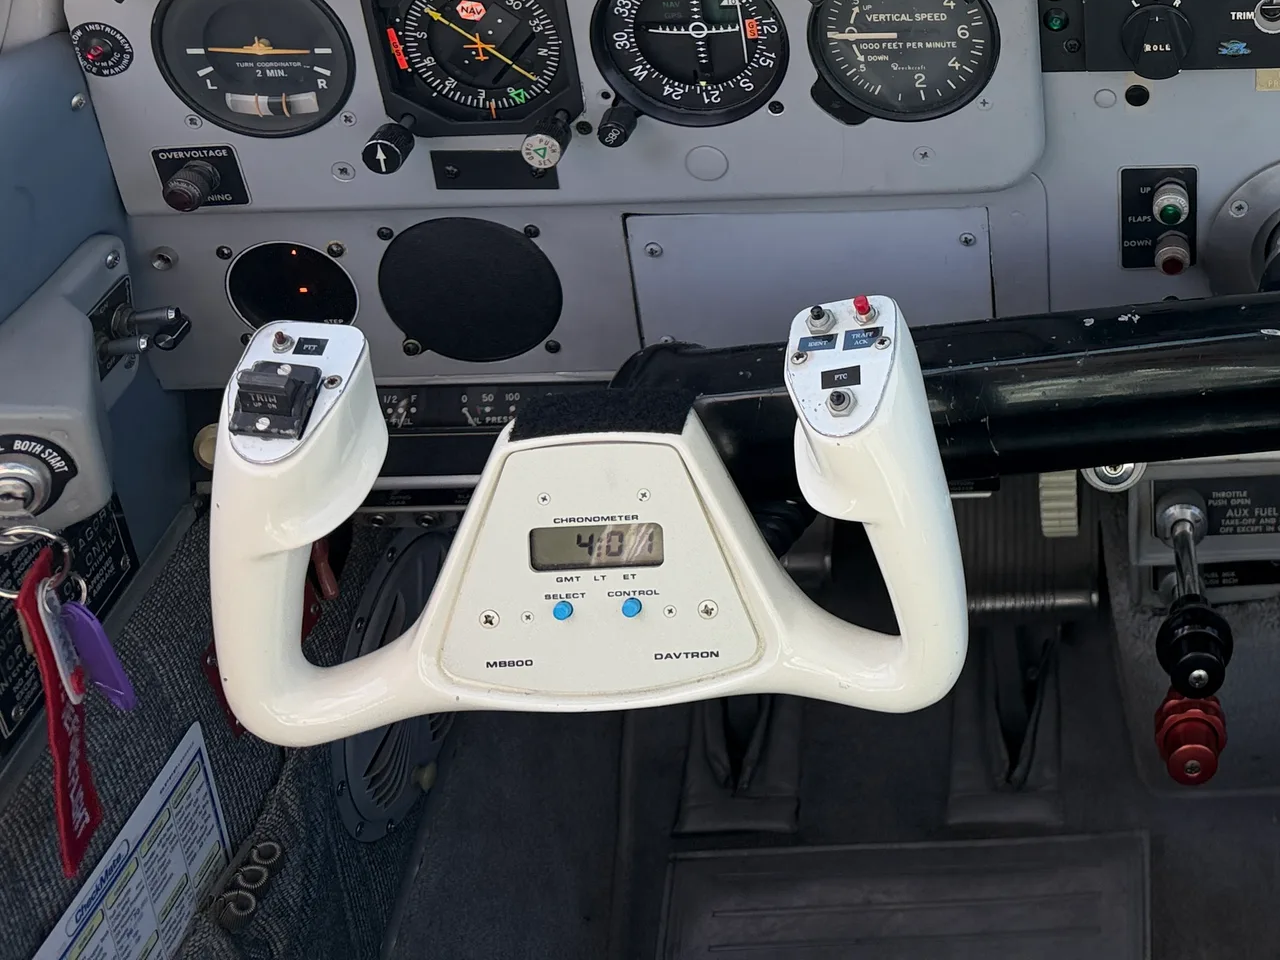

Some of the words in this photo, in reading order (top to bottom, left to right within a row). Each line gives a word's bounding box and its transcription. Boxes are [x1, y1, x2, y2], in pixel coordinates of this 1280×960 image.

[461, 6, 482, 15] NAV
[614, 0, 632, 17] 33
[915, 13, 947, 21] SPEED
[1231, 12, 1254, 20] TRIM
[529, 18, 542, 33] 33
[762, 17, 777, 34] 12
[957, 25, 969, 38] 6
[159, 149, 228, 160] OVERVOLTAGE
[1140, 186, 1151, 194] UP
[1128, 215, 1151, 223] FLAPS
[1124, 240, 1151, 248] DOWN
[13, 440, 44, 455] BOTH
[40, 449, 69, 473] START
[1227, 509, 1248, 517] AUX
[1255, 507, 1278, 516] FUEL
[554, 515, 639, 524] CHRONOMETER
[654, 650, 720, 660] DAVTRON
[73, 852, 122, 924] CheckMate
